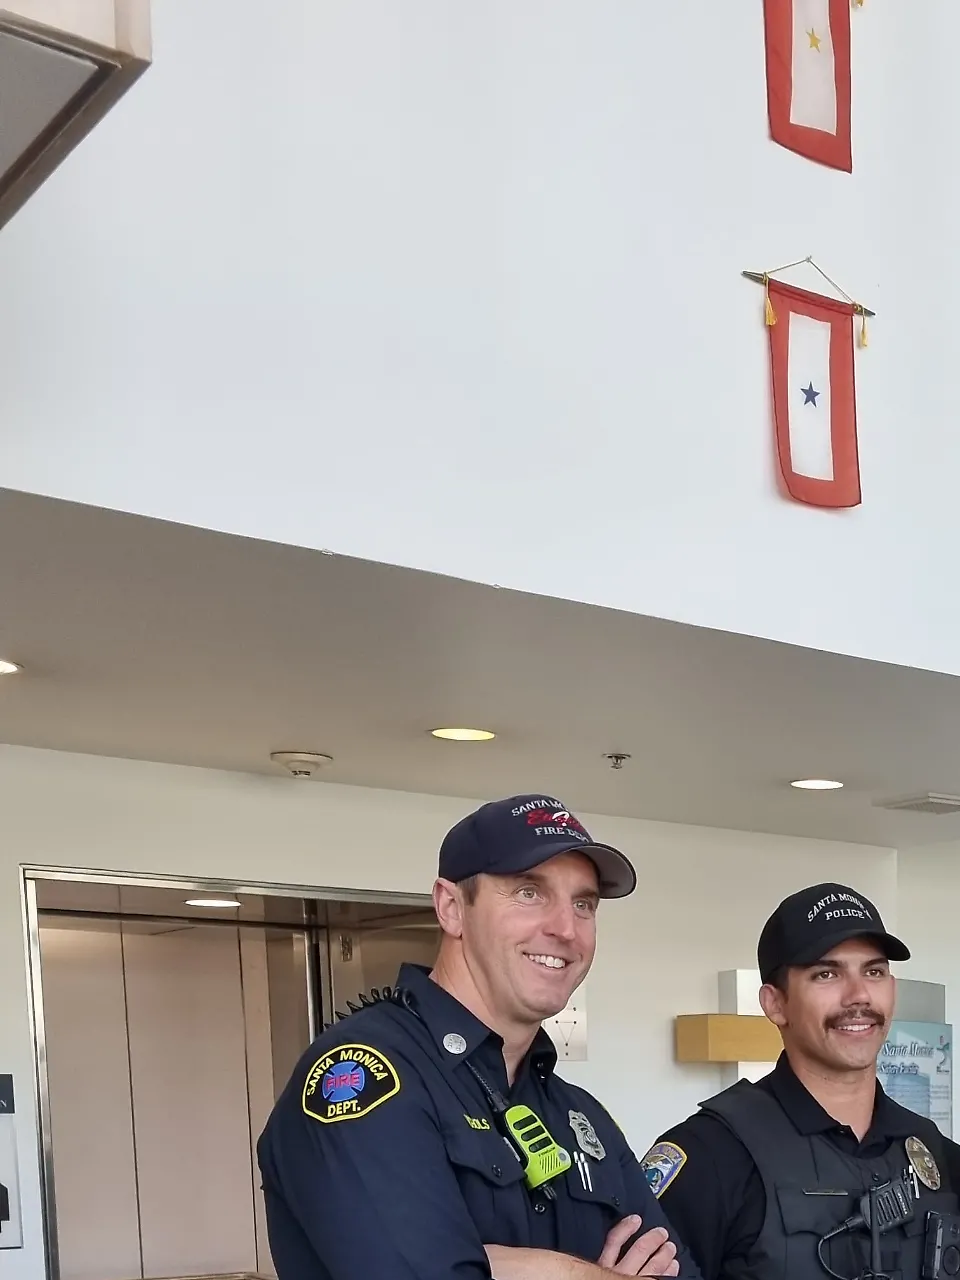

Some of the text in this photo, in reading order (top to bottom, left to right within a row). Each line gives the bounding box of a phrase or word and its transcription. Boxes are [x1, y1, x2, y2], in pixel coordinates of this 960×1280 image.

[511, 799, 550, 817] SANTA
[535, 826, 565, 836] FIRE
[807, 893, 838, 922] SANTA
[825, 908, 865, 921] POLICE
[306, 1049, 389, 1096] SANTA MONICA
[326, 1071, 360, 1090] FIRE
[327, 1100, 361, 1117] DEPT.
